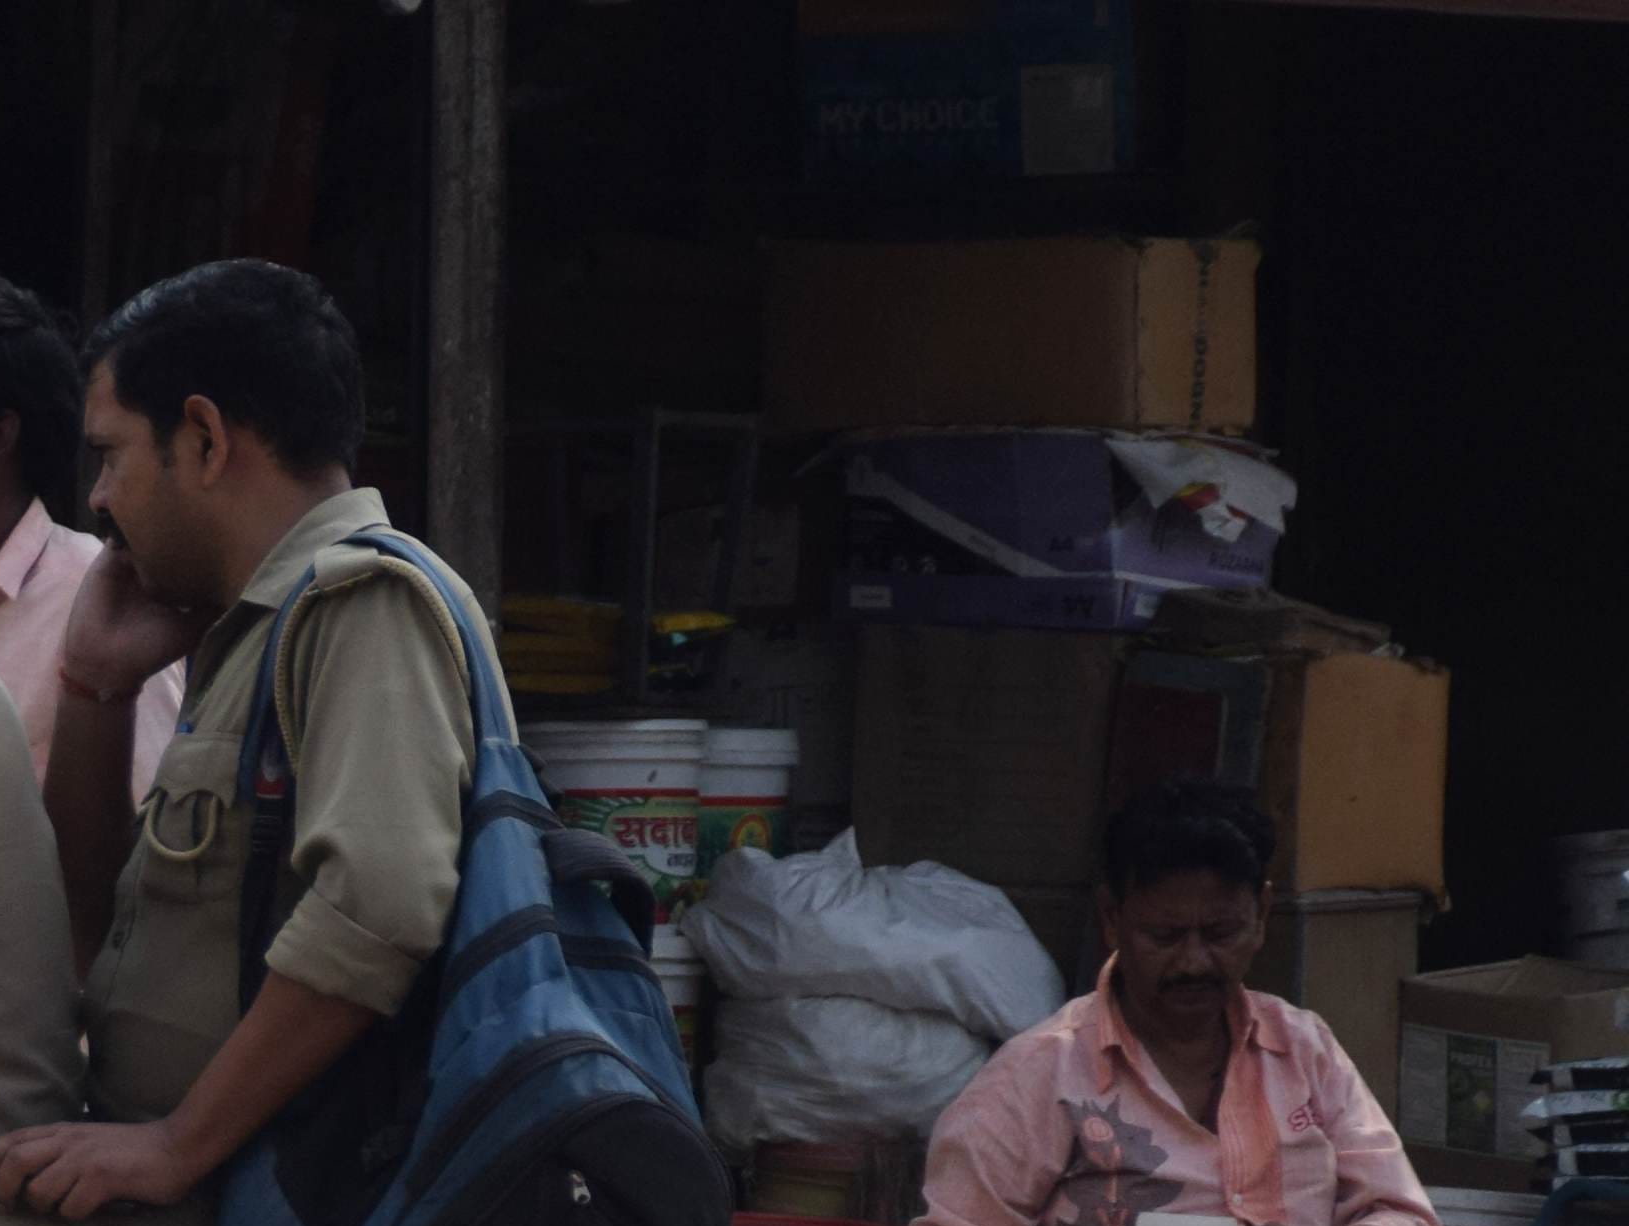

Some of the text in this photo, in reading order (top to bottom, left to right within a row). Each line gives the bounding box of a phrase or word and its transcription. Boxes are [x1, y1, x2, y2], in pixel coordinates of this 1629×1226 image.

[818, 96, 1001, 135] MY CHOICE
[611, 816, 698, 849] सदाब
